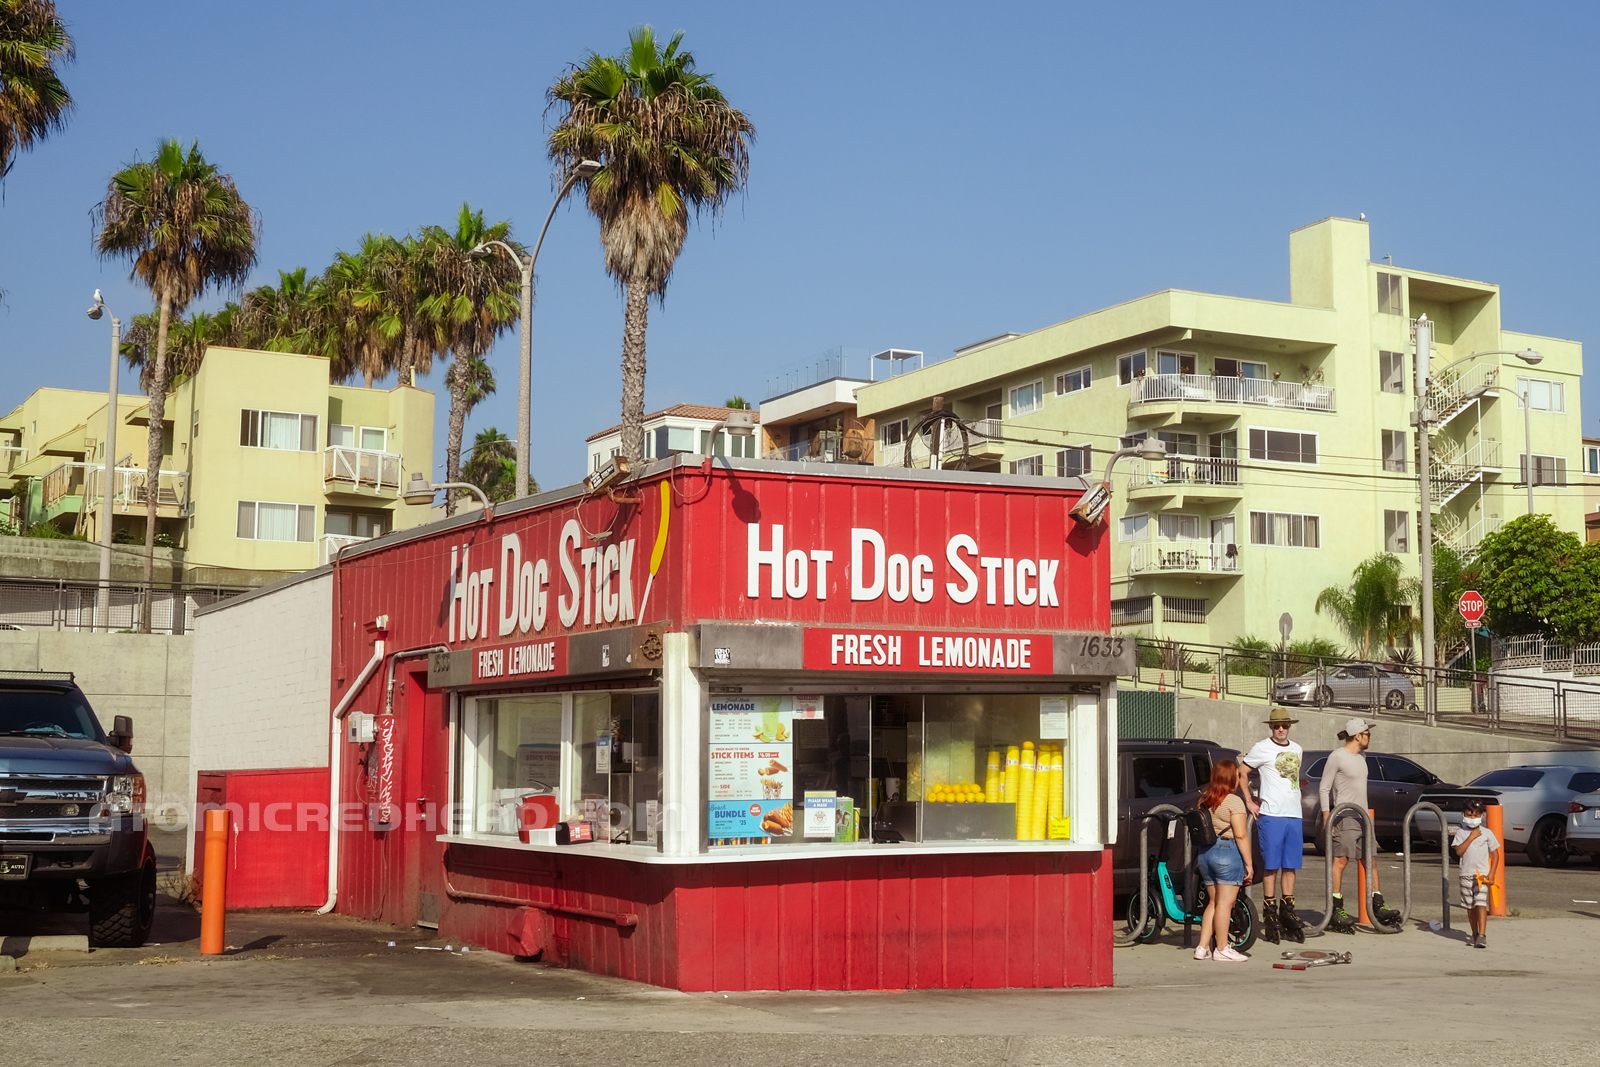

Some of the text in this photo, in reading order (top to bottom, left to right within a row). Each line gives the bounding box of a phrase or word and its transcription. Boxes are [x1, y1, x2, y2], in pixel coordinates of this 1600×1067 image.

[1461, 600, 1483, 612] STOP
[831, 634, 1031, 669] FRESH LEMONADE
[1079, 636, 1126, 658] 1633
[478, 642, 555, 679] FRESH LEMONADE
[712, 703, 755, 711] LEMONADE
[714, 810, 746, 819] BUNDLE
